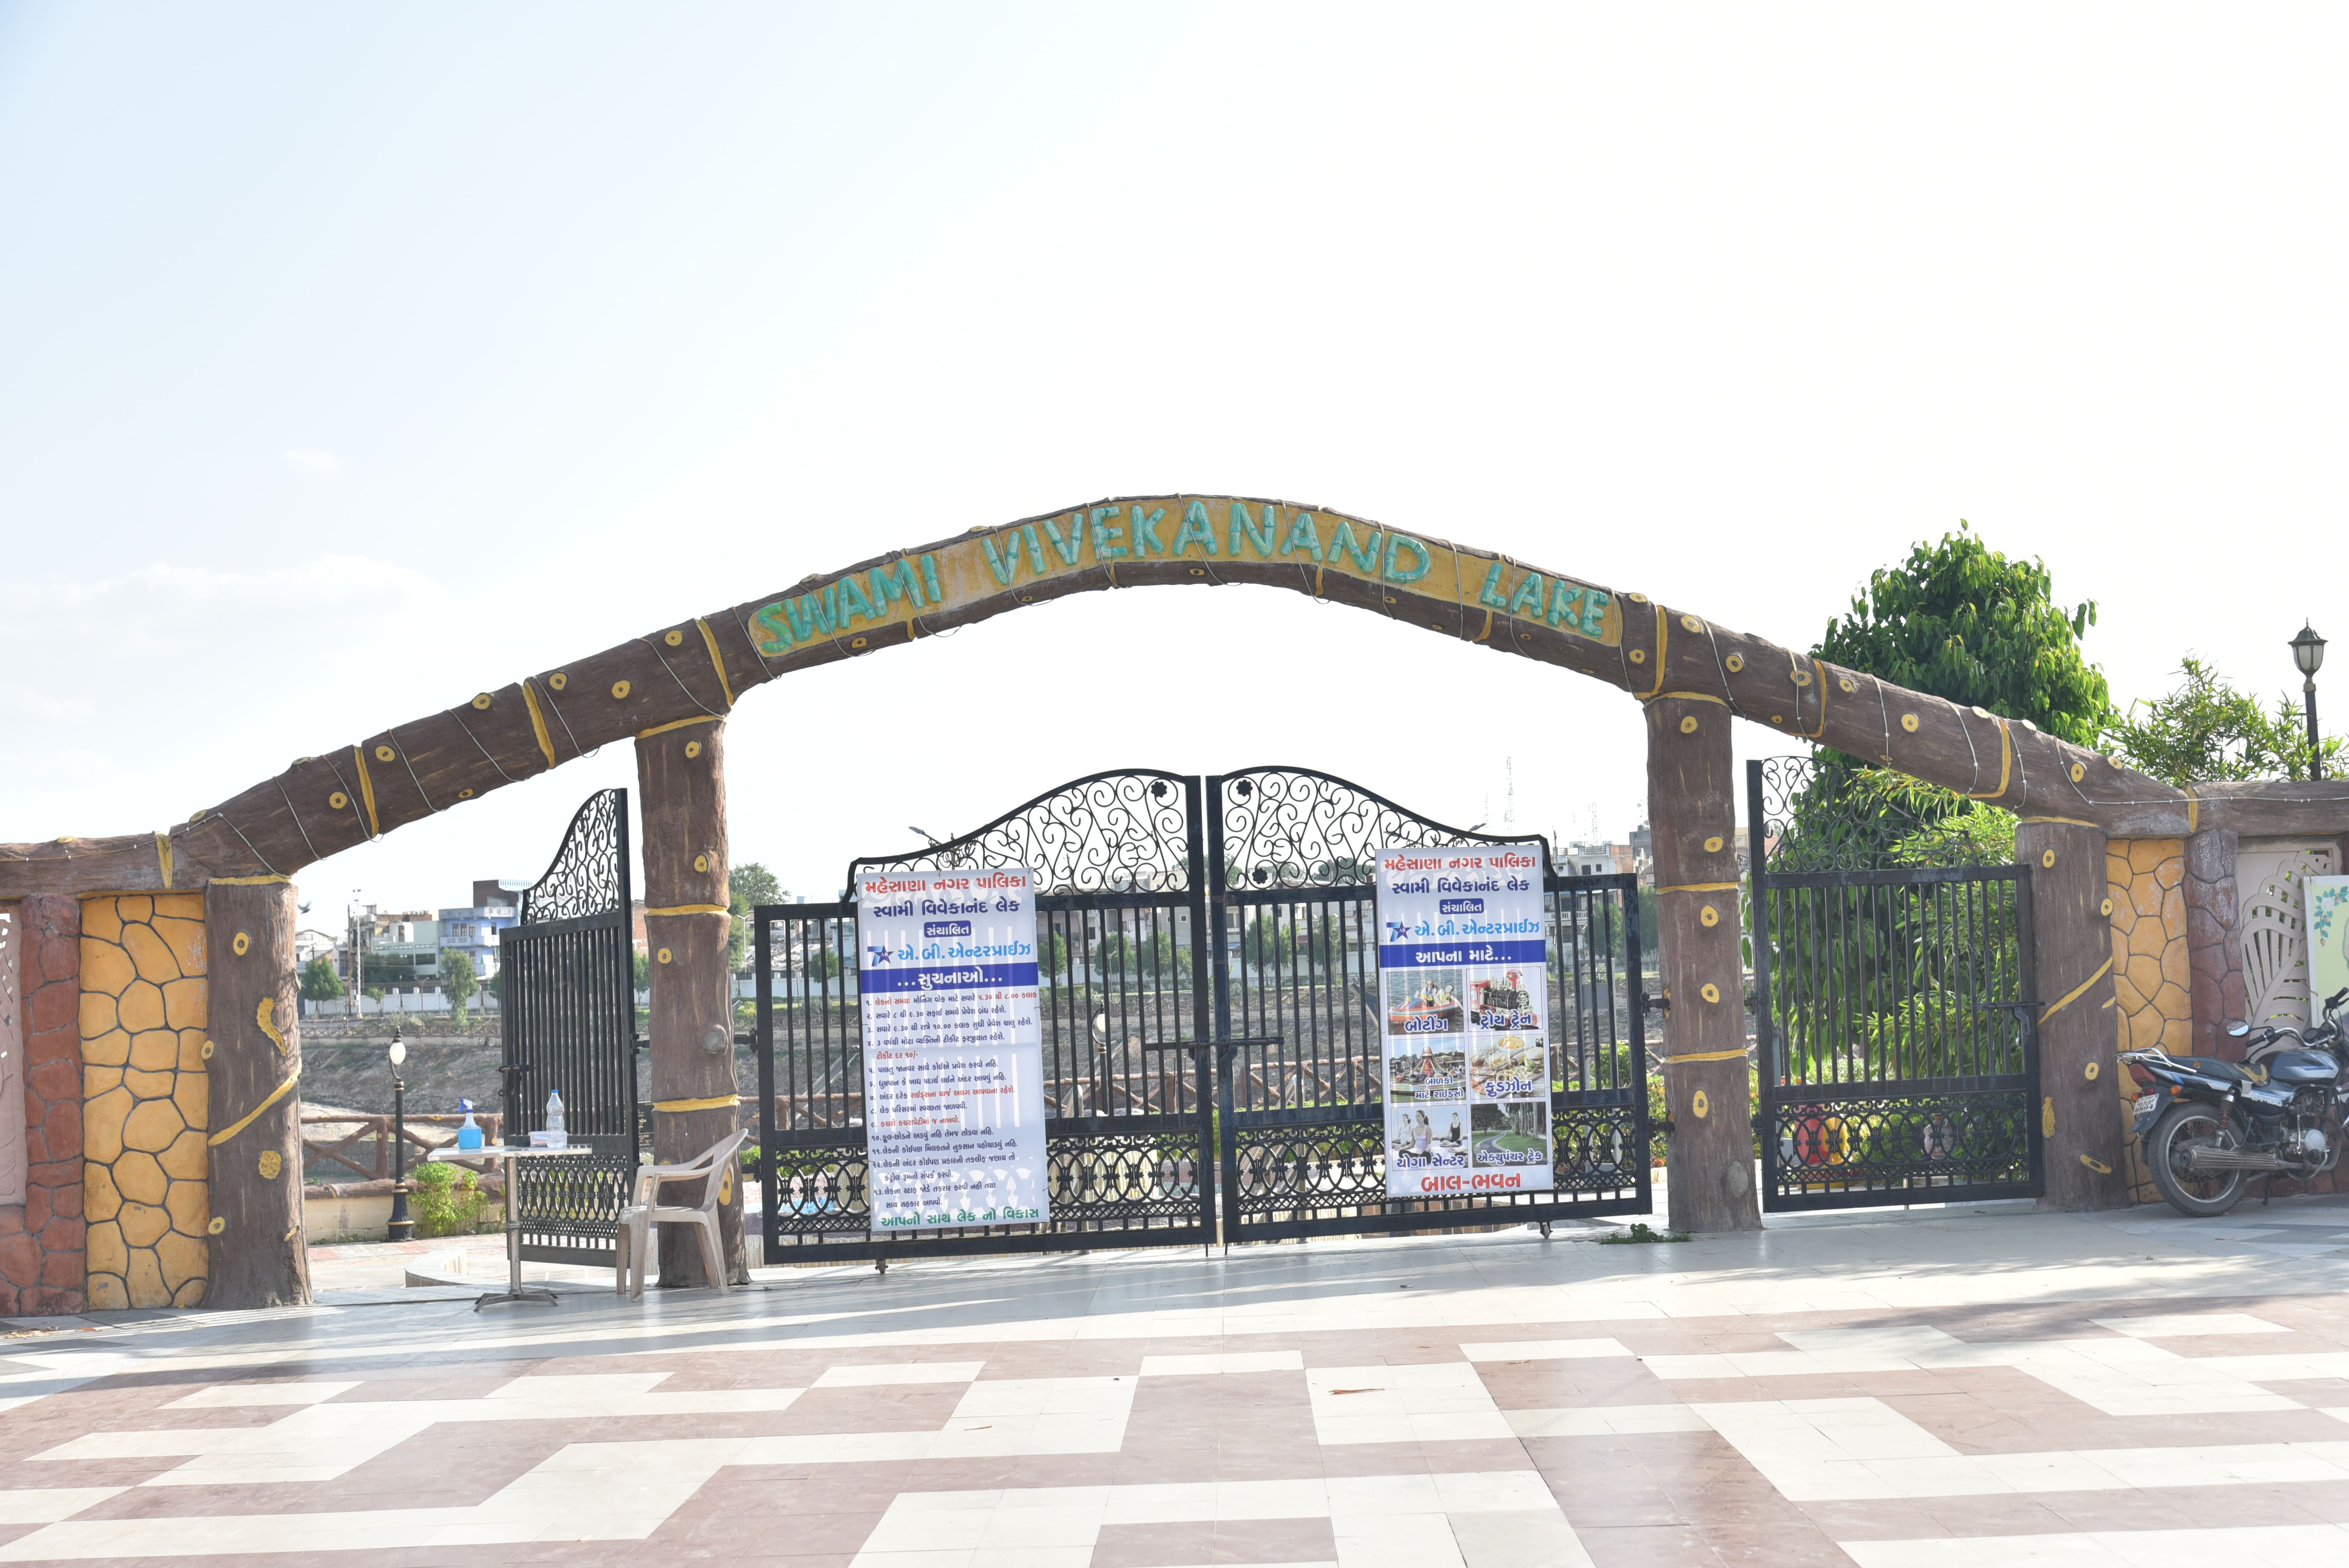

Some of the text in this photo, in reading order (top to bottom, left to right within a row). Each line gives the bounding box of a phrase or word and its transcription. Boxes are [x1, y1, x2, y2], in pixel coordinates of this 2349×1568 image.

[757, 500, 1610, 653] SWAMI VIVEKANAND LAKE
[1384, 852, 1536, 871] મહેસાણા નગર પાલિકા
[865, 871, 1026, 894] મહેસાણા નગર પાલિકા
[1392, 875, 1530, 894] સ્વામી વિવેકાનંદ લેક
[873, 896, 1020, 918] સ્વામી વિવેકાનંદ લેક
[1442, 901, 1482, 913] સંચાલિત
[926, 923, 970, 936] સંચાલિત
[1415, 950, 1462, 963] આપના
[961, 993, 975, 1001] સવારે
[995, 991, 1002, 1000] થી
[876, 1010, 890, 1019] સવારે
[927, 1009, 942, 1017] સફાઈ
[945, 1007, 959, 1015] સમયે
[1511, 1009, 1531, 1029] ટ્રેન
[876, 1024, 891, 1032] સવારે
[920, 1022, 930, 1030] રાત્રે
[973, 1019, 984, 1030] સુધી
[1003, 1019, 1015, 1028] ચાલુ
[1405, 1015, 1448, 1033] બોટીંગ
[943, 1034, 959, 1042] ટીકીટ
[962, 1035, 987, 1043] ફરજીયાત
[877, 1051, 892, 1060] ટીકીટ
[918, 1062, 929, 1071] સાથે
[932, 1062, 949, 1070] કોઈએ
[952, 1061, 966, 1069] પ્રવેશ
[968, 1060, 982, 1068] કરવો
[986, 1059, 998, 1067] નહિ.
[902, 1077, 906, 1085] કે
[924, 1076, 939, 1084] પદાર્થ
[941, 1074, 955, 1083] લઈને
[974, 1073, 991, 1083] આવવું
[993, 1072, 1006, 1081] નહિ.
[1425, 1074, 1453, 1085] બાળકો
[896, 1091, 907, 1099] દરેક
[1415, 1089, 1429, 1099] માટે
[893, 1104, 916, 1113] પરિસરમાં
[880, 1118, 896, 1127] કચરો
[898, 1117, 929, 1126] કચરાપેટીમાં
[913, 1131, 929, 1141] અડવું
[931, 1130, 942, 1138] નહિ
[980, 1127, 993, 1135] નહિ.
[902, 1145, 922, 1153] કોઈપણ
[925, 1142, 950, 1152] મિલકતને
[953, 1144, 974, 1152] નુકસાન
[1005, 1139, 1018, 1147] નહિ.
[919, 1157, 939, 1165] કોઈપણ
[942, 1155, 963, 1164] પ્રકારની
[966, 1154, 986, 1163] તકલીફ
[1009, 1152, 1015, 1160] તો
[1397, 1153, 1464, 1168] યોગા સેન્ટર
[1528, 1149, 1542, 1163] ટ્રેક
[920, 1184, 930, 1192] જોડે
[954, 1182, 968, 1190] કરવી
[971, 1181, 982, 1189] નહી
[1421, 1173, 1521, 1192] બાલ-ભવન
[881, 1212, 920, 1226] આપનો
[927, 1213, 951, 1224] સાથ
[957, 1208, 976, 1222] લેક
[1003, 1206, 1039, 1219] વિકાસ
